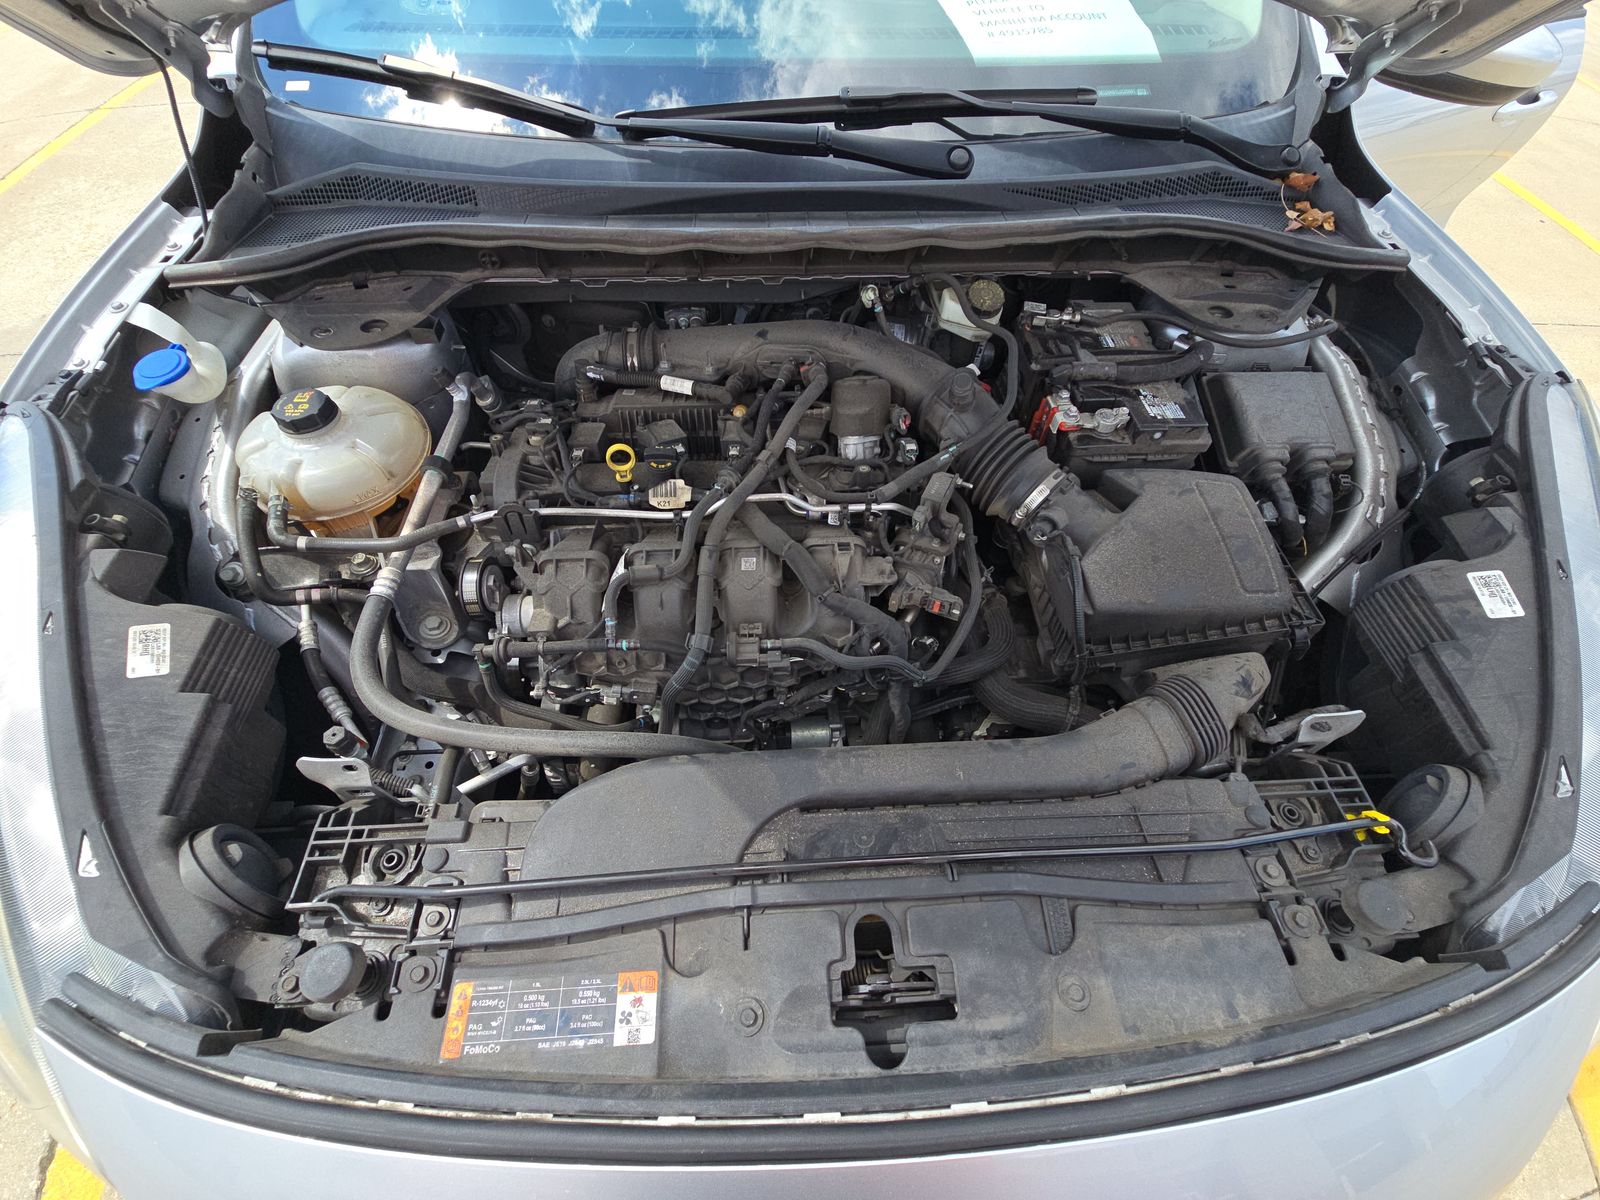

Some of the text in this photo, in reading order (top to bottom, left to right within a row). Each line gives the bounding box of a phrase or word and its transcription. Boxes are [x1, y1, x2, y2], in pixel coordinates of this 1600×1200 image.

[1050, 12, 1108, 21] ACCOUNT
[538, 994, 545, 1002] kg
[593, 990, 600, 998] kg
[471, 998, 498, 1008] R-1234yf
[526, 1017, 537, 1025] PAG
[468, 1023, 483, 1031] PAG
[538, 1041, 550, 1049] SAE
[463, 1044, 501, 1055] FoMoCo
